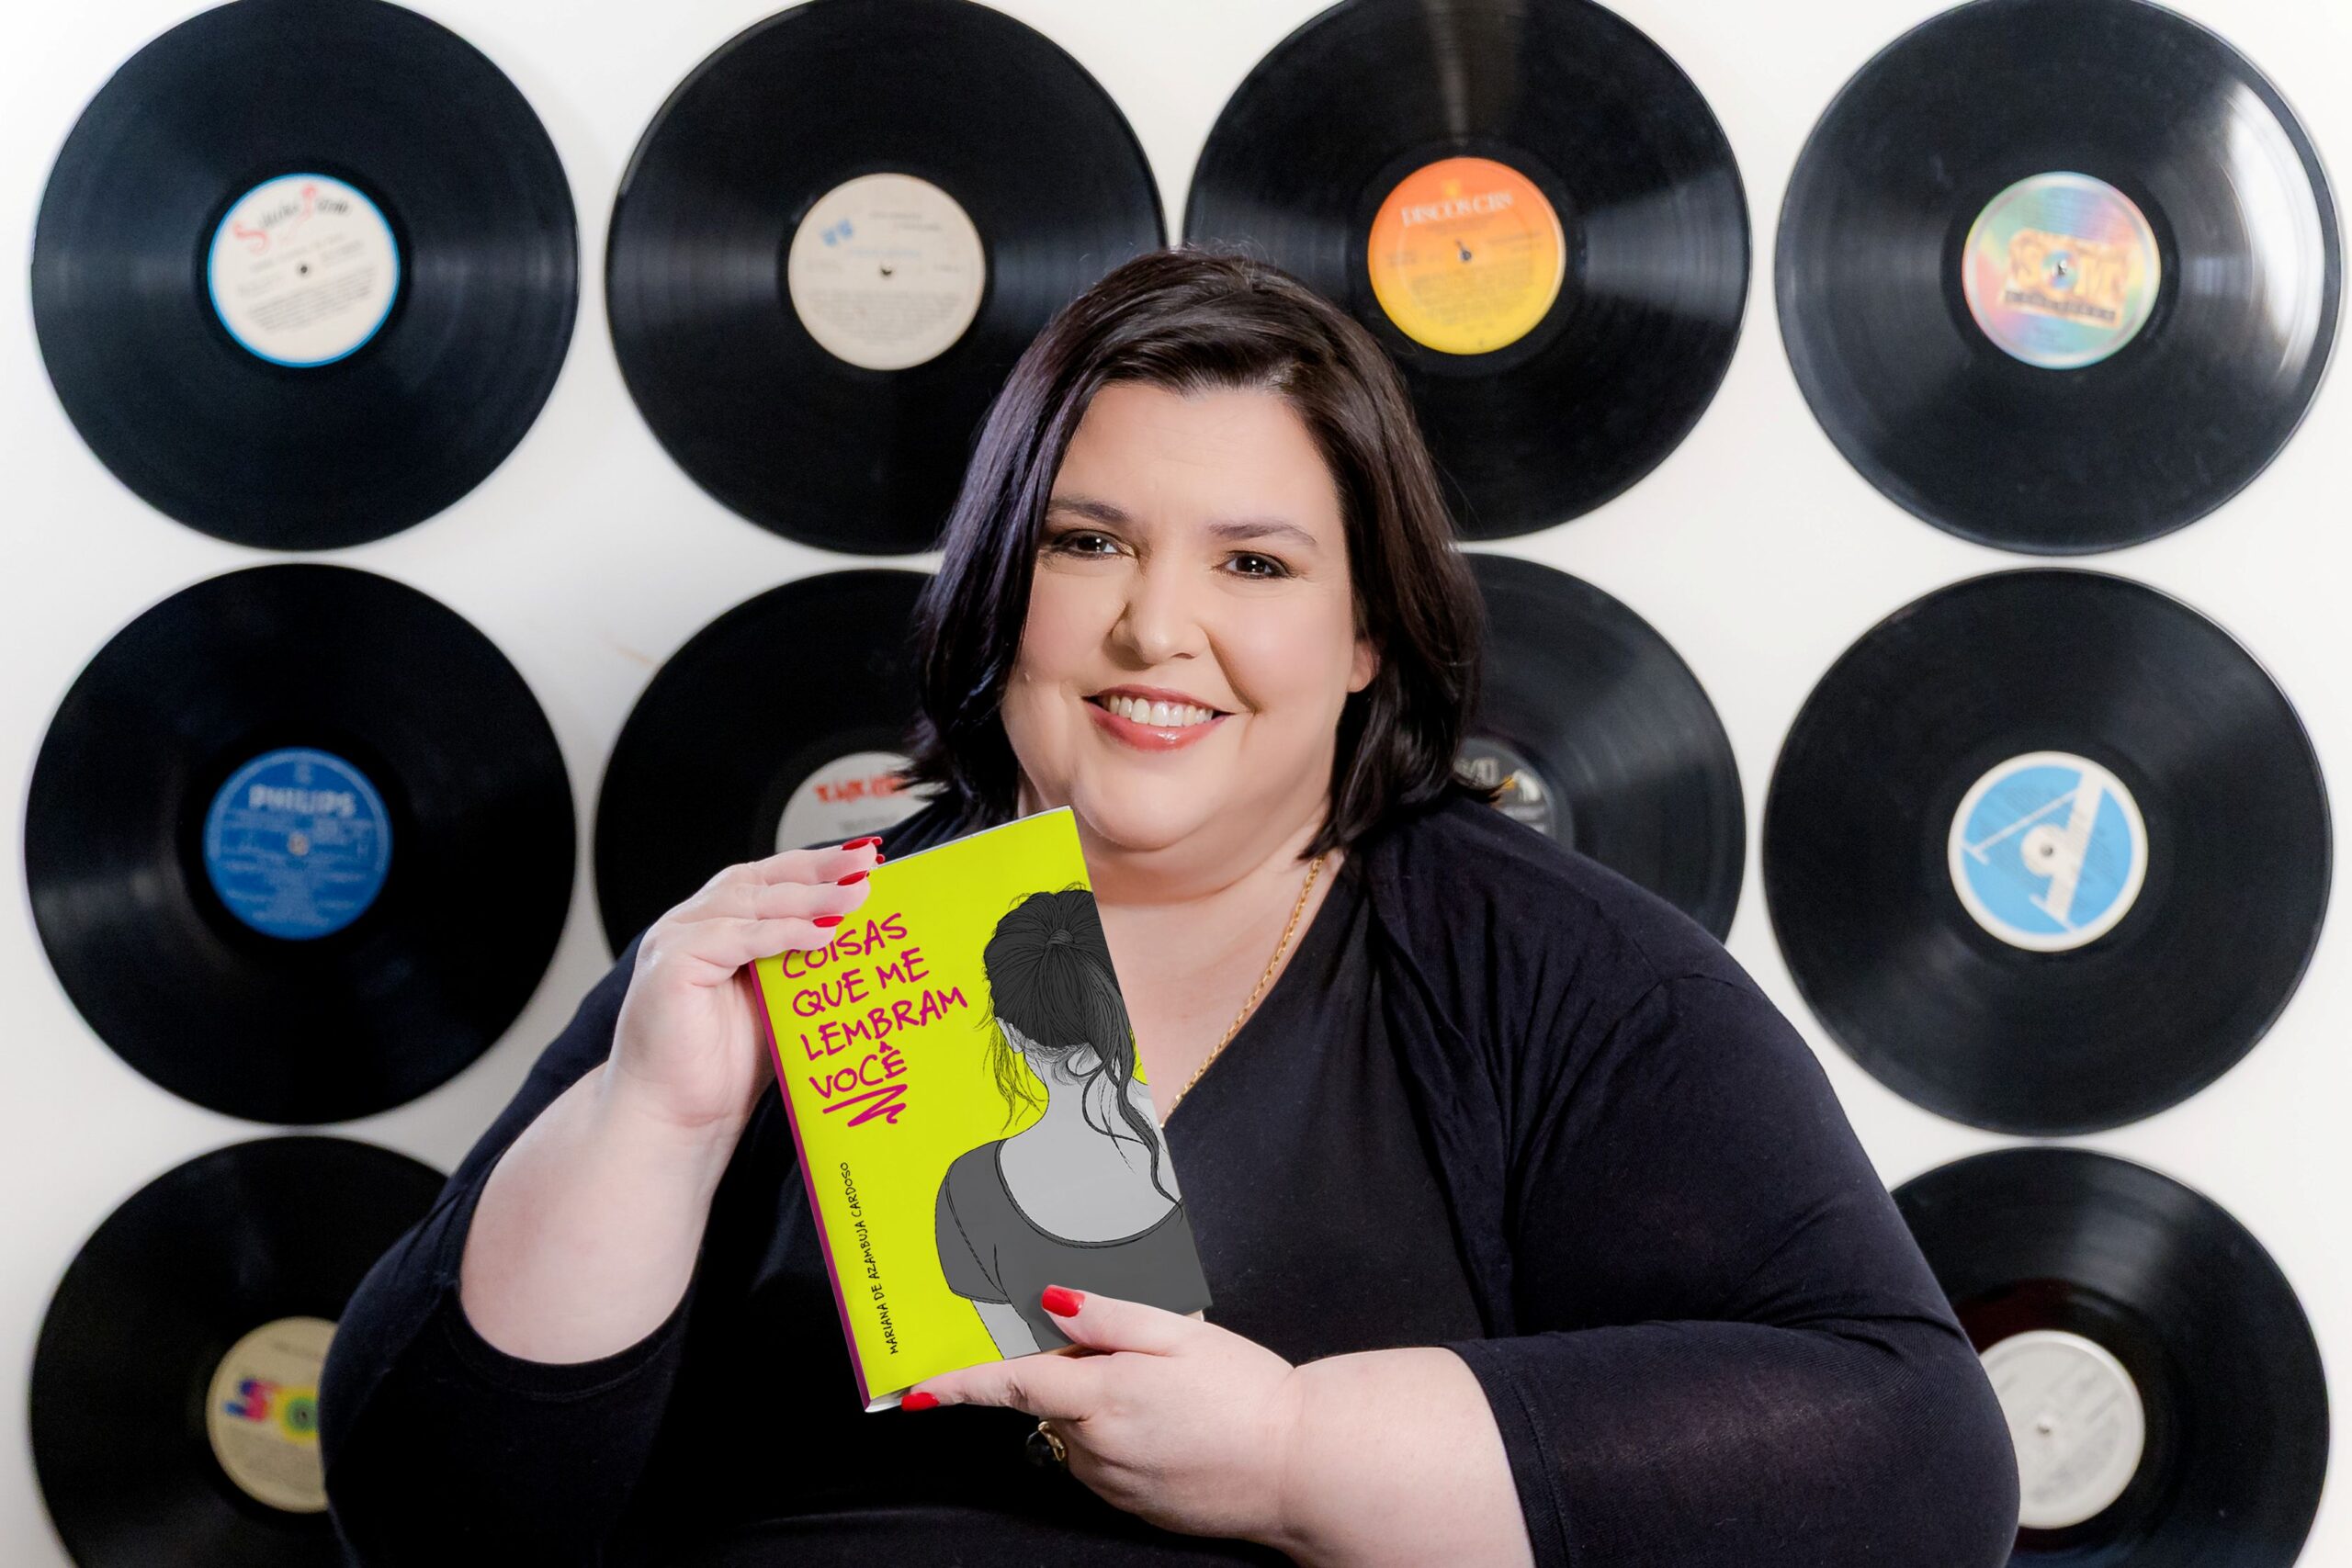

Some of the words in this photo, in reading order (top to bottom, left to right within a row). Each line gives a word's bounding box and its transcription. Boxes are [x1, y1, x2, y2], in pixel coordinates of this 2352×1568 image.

[248, 783, 356, 818] PHILIPS
[782, 912, 908, 979] COISAS
[792, 968, 869, 1018] QUE
[875, 947, 930, 990] ME
[800, 986, 968, 1061] LEMBRAM
[808, 1041, 908, 1099] VOCÊ
[840, 1162, 862, 1217] CARDOSO
[854, 1220, 880, 1280] AZAMBUJA
[871, 1283, 885, 1301] DE
[876, 1303, 899, 1355] MARIANA
